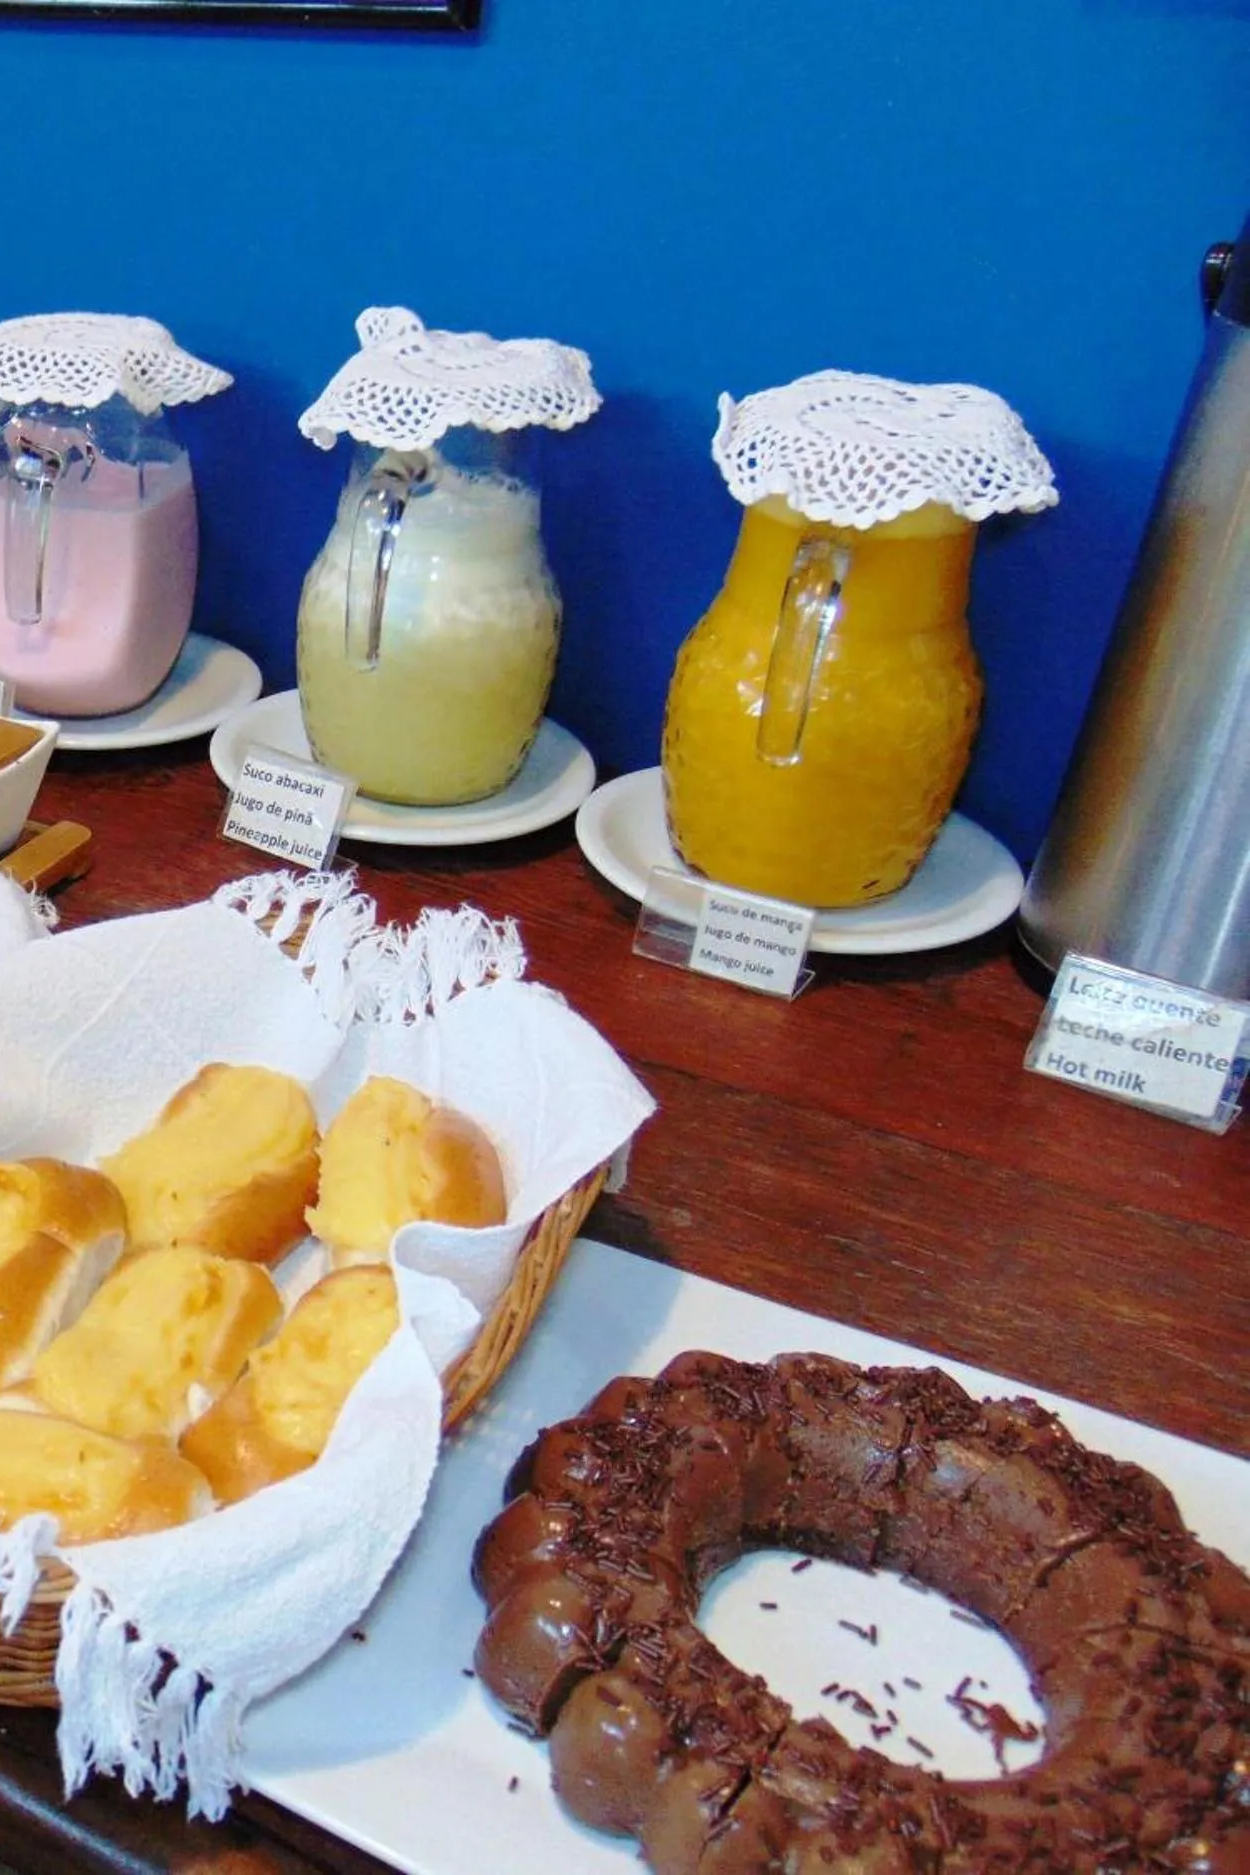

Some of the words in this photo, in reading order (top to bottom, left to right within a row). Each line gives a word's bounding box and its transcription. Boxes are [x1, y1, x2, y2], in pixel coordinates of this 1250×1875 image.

[243, 763, 273, 783] Suco
[276, 773, 325, 799] abacaxi
[235, 792, 264, 812] Jugo
[266, 801, 283, 816] de
[227, 820, 289, 849] Pineapple
[290, 841, 322, 860] juice
[709, 900, 740, 915] Suco
[742, 907, 758, 919] de
[704, 925, 733, 940] Jugo
[735, 932, 752, 944] de
[753, 938, 797, 957] mango
[699, 948, 743, 969] Mango
[743, 959, 775, 978] juice
[1130, 1037, 1230, 1073] caliente
[1046, 1052, 1091, 1078] Hot
[1093, 1065, 1147, 1093] milk
